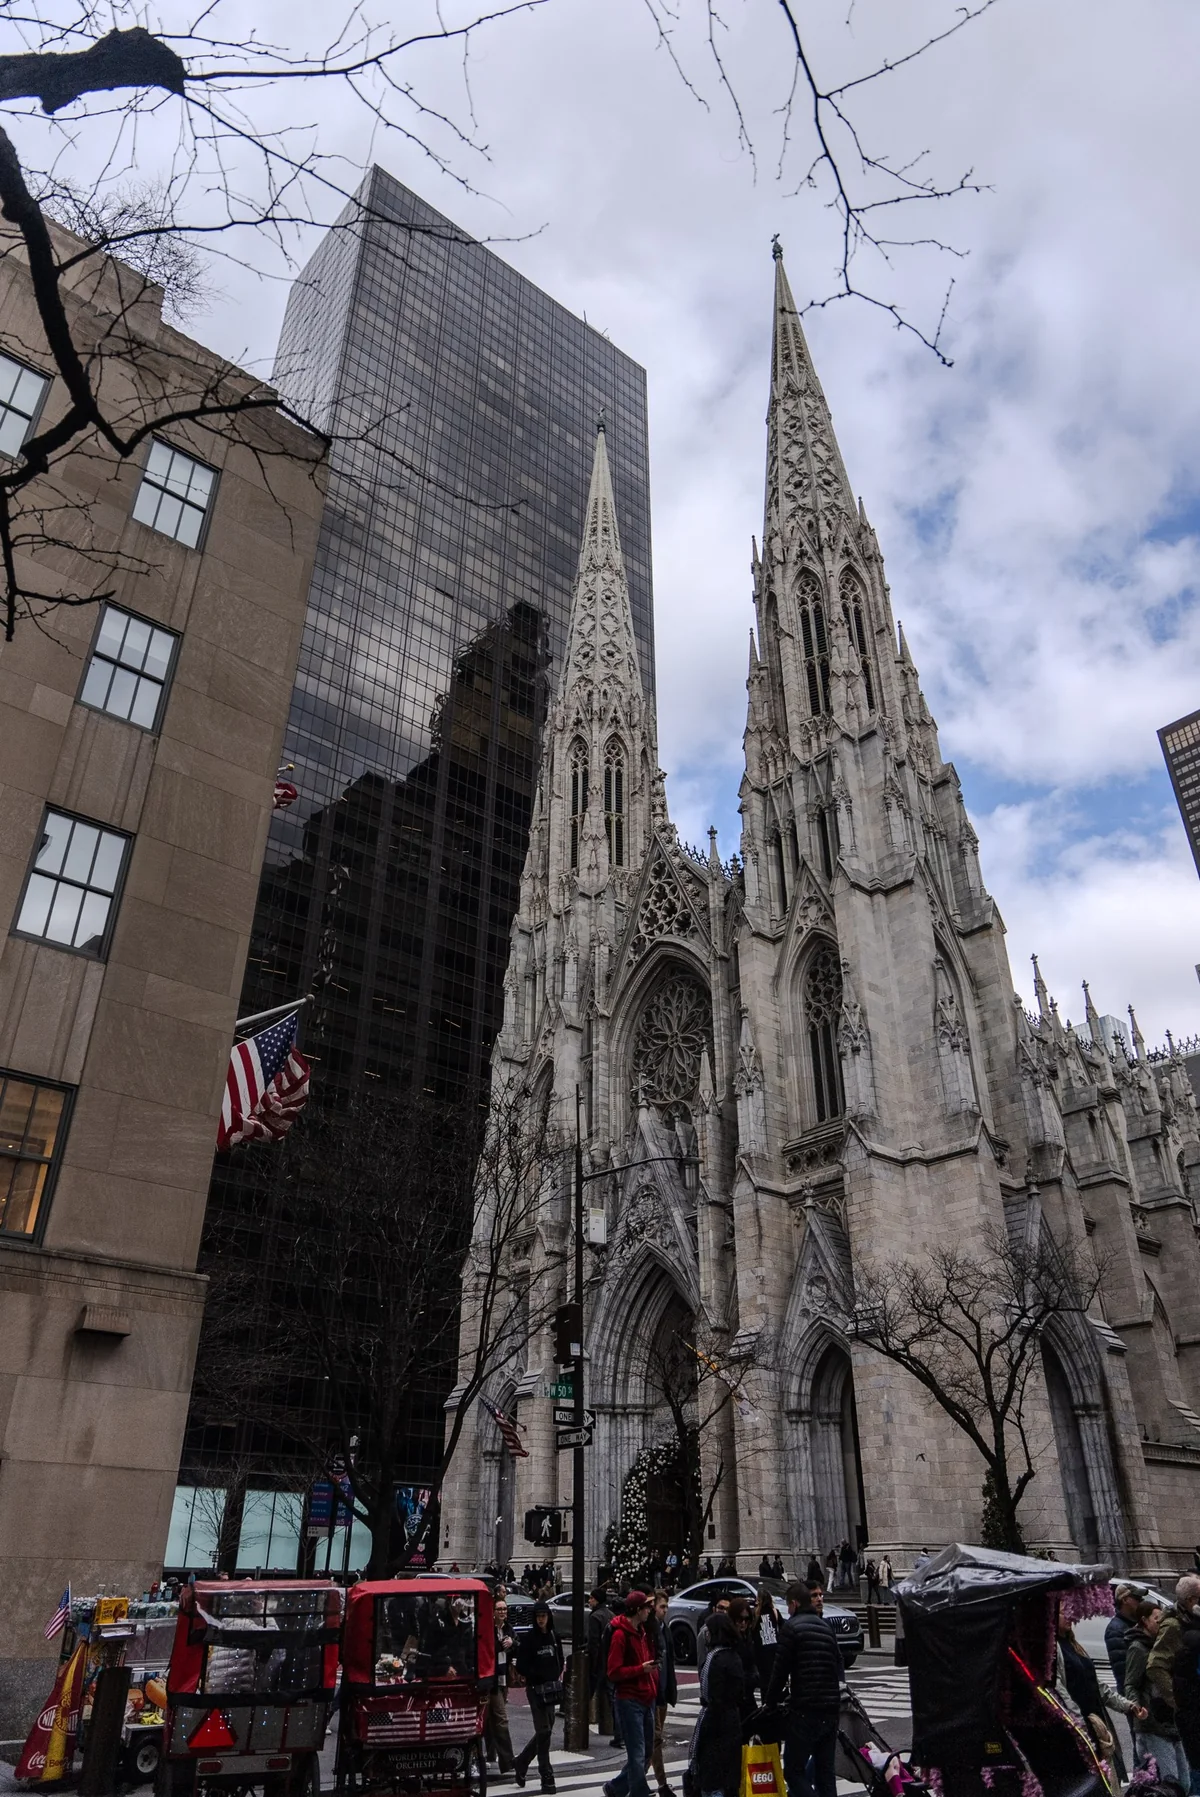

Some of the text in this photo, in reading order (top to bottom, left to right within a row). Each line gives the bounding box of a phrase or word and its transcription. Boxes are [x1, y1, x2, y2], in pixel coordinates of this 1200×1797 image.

[550, 1385, 557, 1397] W
[558, 1385, 567, 1397] 50
[559, 1412, 572, 1421] ONE
[560, 1432, 587, 1444] ONE WAY
[388, 1751, 443, 1762] WORLD PEACE
[753, 1771, 773, 1783] LEGO
